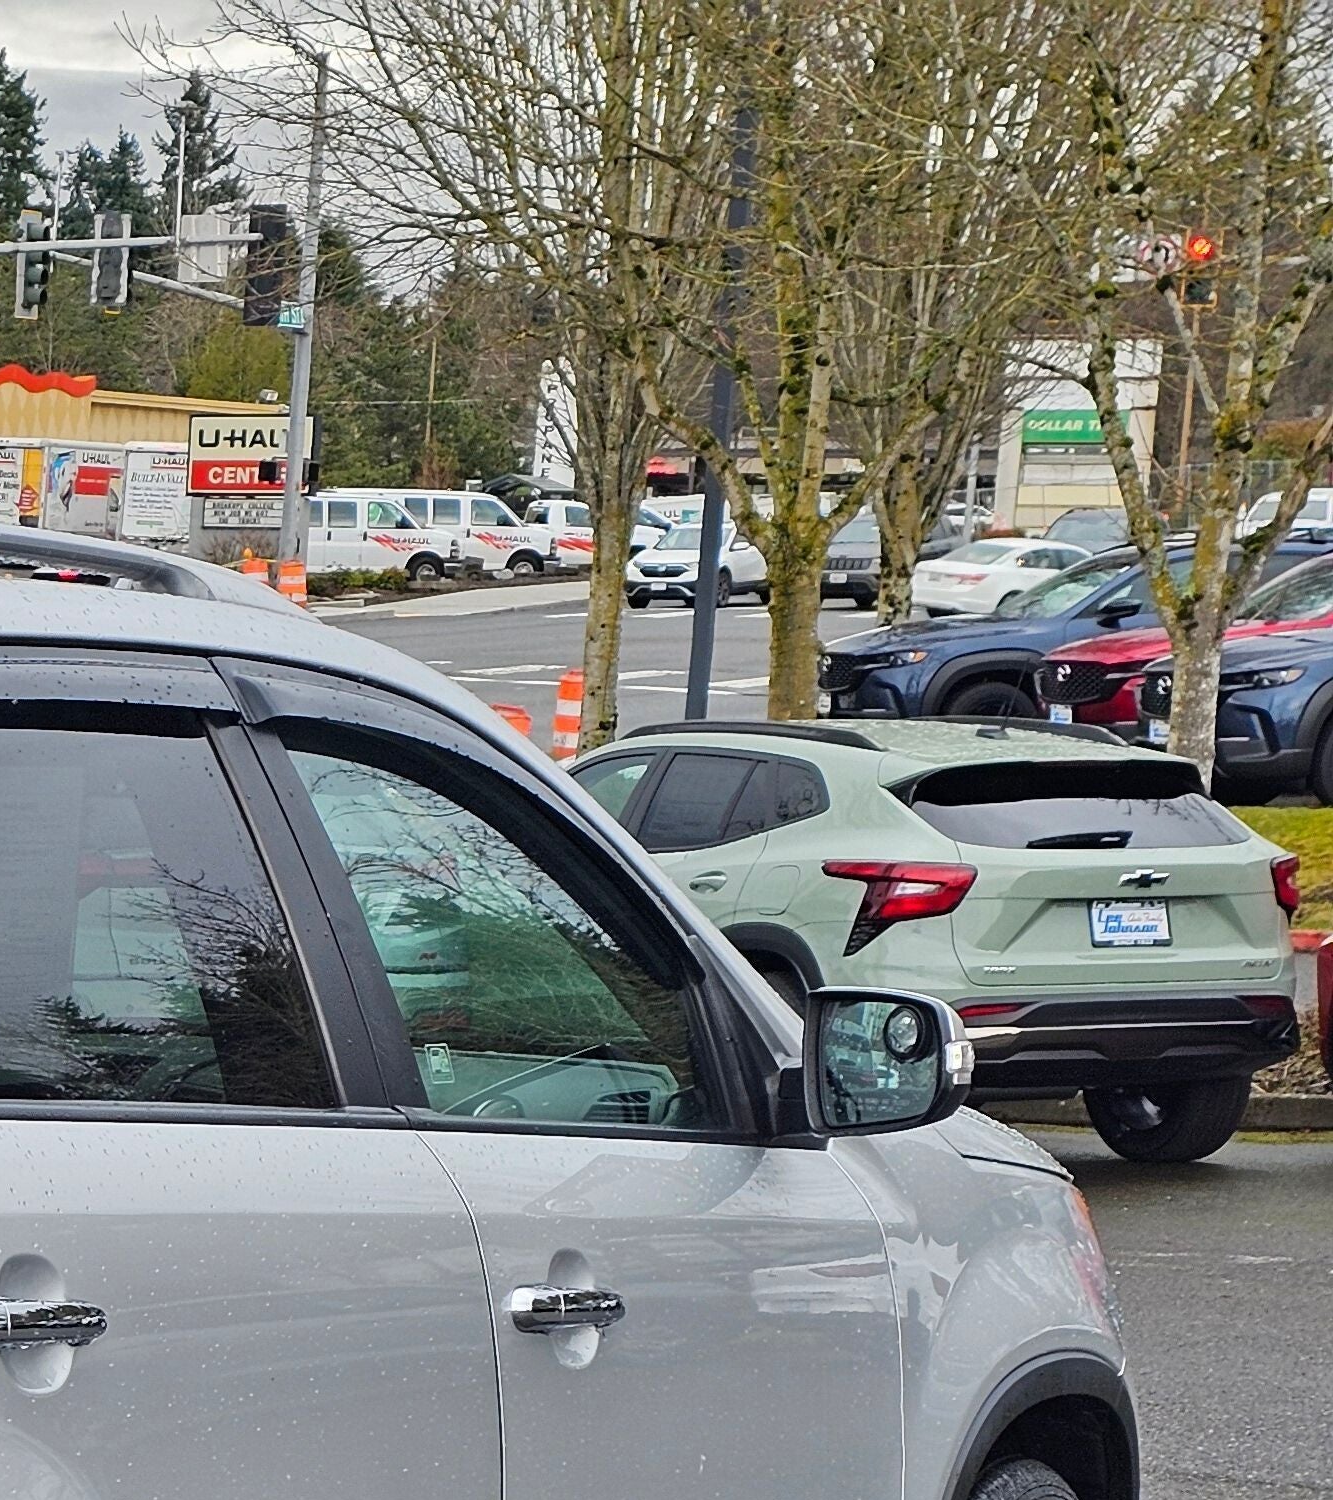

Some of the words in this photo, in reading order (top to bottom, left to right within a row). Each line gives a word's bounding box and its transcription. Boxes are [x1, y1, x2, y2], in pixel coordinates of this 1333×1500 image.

[198, 428, 288, 448] U-HAU
[152, 456, 190, 466] U-HAU
[208, 466, 289, 485] CENT
